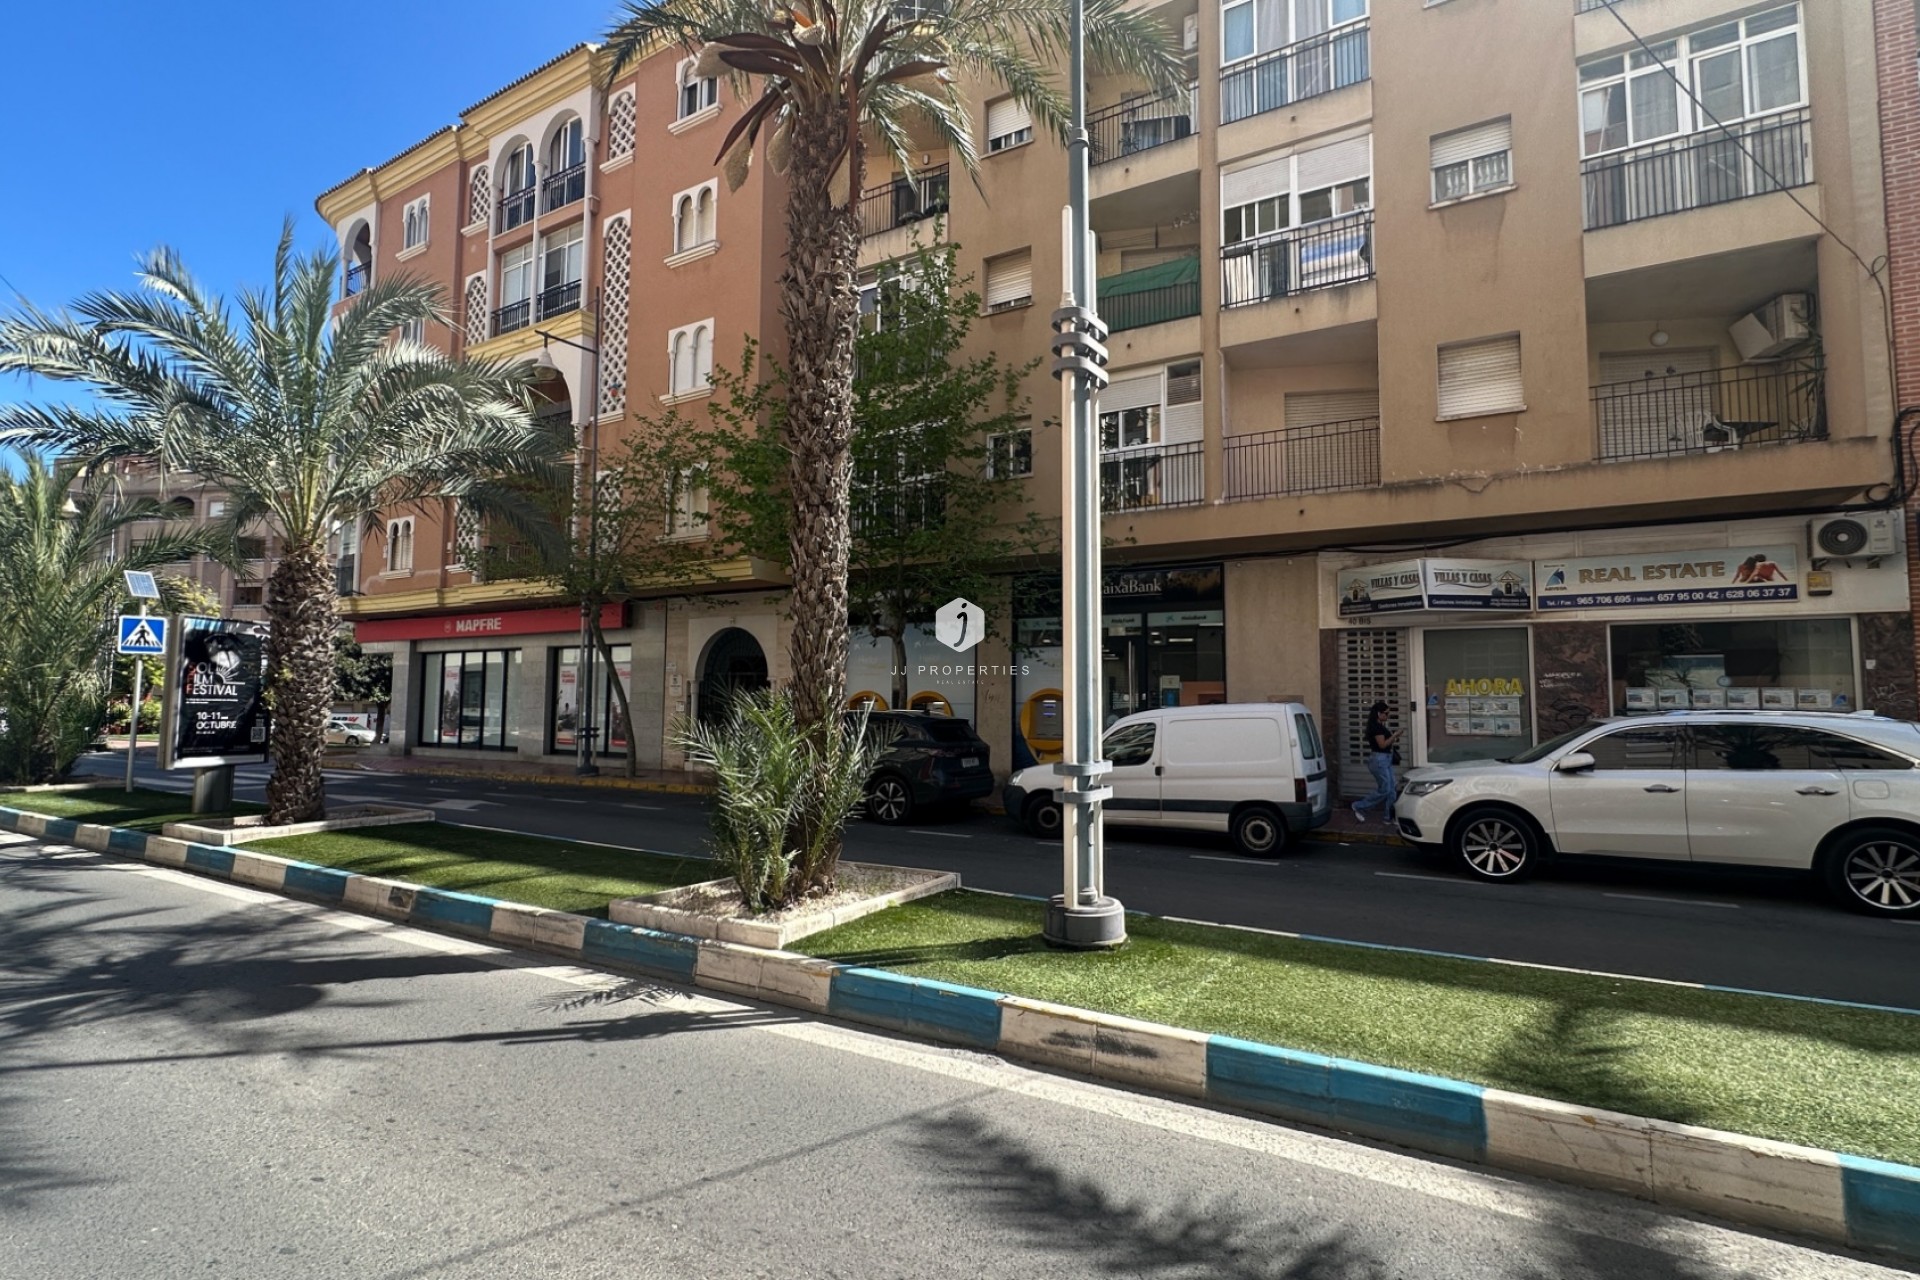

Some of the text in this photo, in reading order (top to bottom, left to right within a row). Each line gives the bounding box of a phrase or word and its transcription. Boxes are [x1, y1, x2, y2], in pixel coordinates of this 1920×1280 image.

[1434, 572, 1491, 583] VILLAS Y CASAS
[1578, 561, 1725, 583] REAL ESTATE
[1103, 578, 1162, 595] aixaBank
[1371, 576, 1392, 588] VILLAS
[1394, 576, 1399, 586] Y
[1577, 597, 1593, 605] 965
[1614, 595, 1631, 603] 695
[1658, 593, 1674, 601] 657
[1677, 592, 1689, 600] 95
[1692, 591, 1703, 600] 00
[1707, 591, 1718, 599] 42
[1726, 590, 1744, 598] 628
[1747, 589, 1759, 597] 06
[1762, 588, 1775, 596] 37
[1778, 588, 1791, 596] 37
[456, 617, 502, 632] MAPFRE
[186, 684, 237, 695] FESTIVAL
[1445, 679, 1524, 695] AHORA
[196, 721, 237, 729] OCTUBRE
